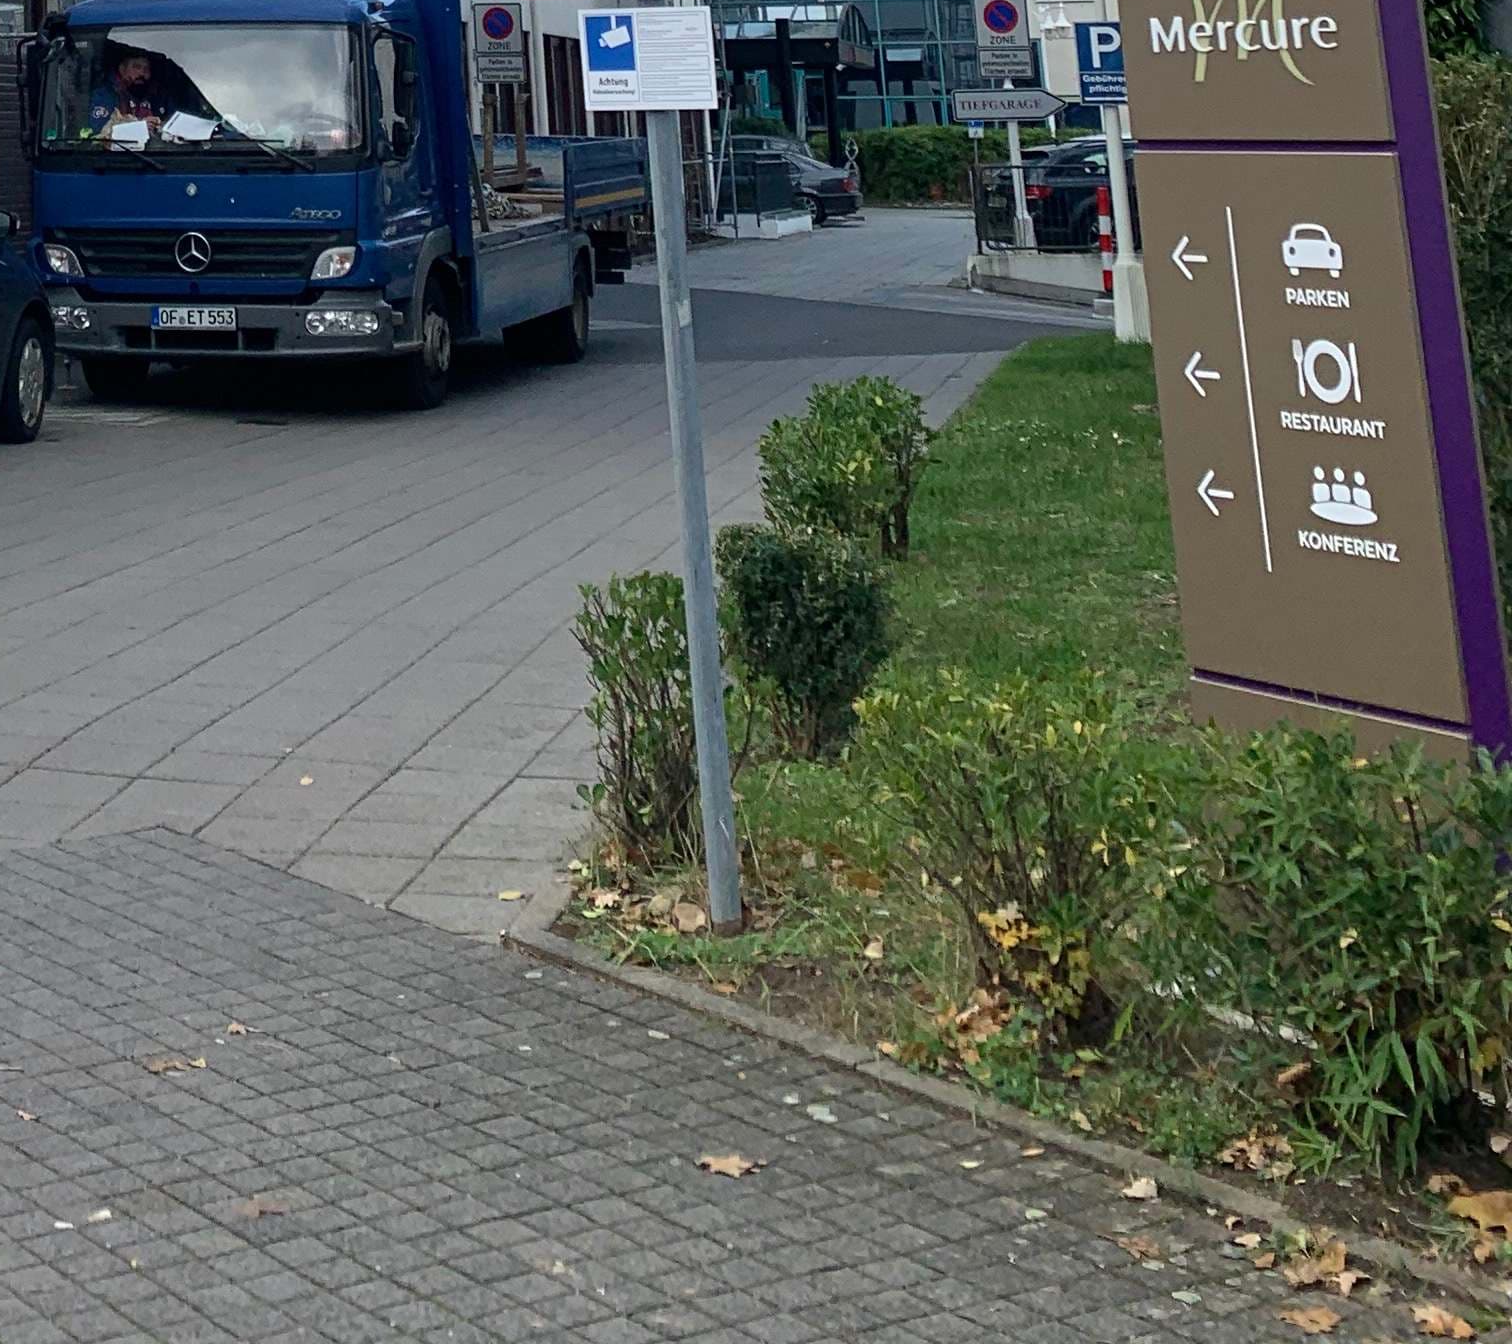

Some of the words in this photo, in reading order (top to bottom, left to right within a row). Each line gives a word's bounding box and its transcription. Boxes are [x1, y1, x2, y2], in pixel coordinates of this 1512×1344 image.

[990, 35, 1016, 45] ZONE
[1148, 15, 1339, 54] Mercure
[1089, 26, 1121, 69] P
[599, 77, 628, 87] Achtung
[959, 98, 1042, 110] TIEFGARAGE
[1285, 287, 1351, 309] PARKEN
[160, 309, 178, 325] OF
[187, 309, 205, 325] ET
[207, 309, 234, 325] 553
[1280, 410, 1386, 440] RESTAURANT
[1298, 529, 1400, 563] KONFERENZ
